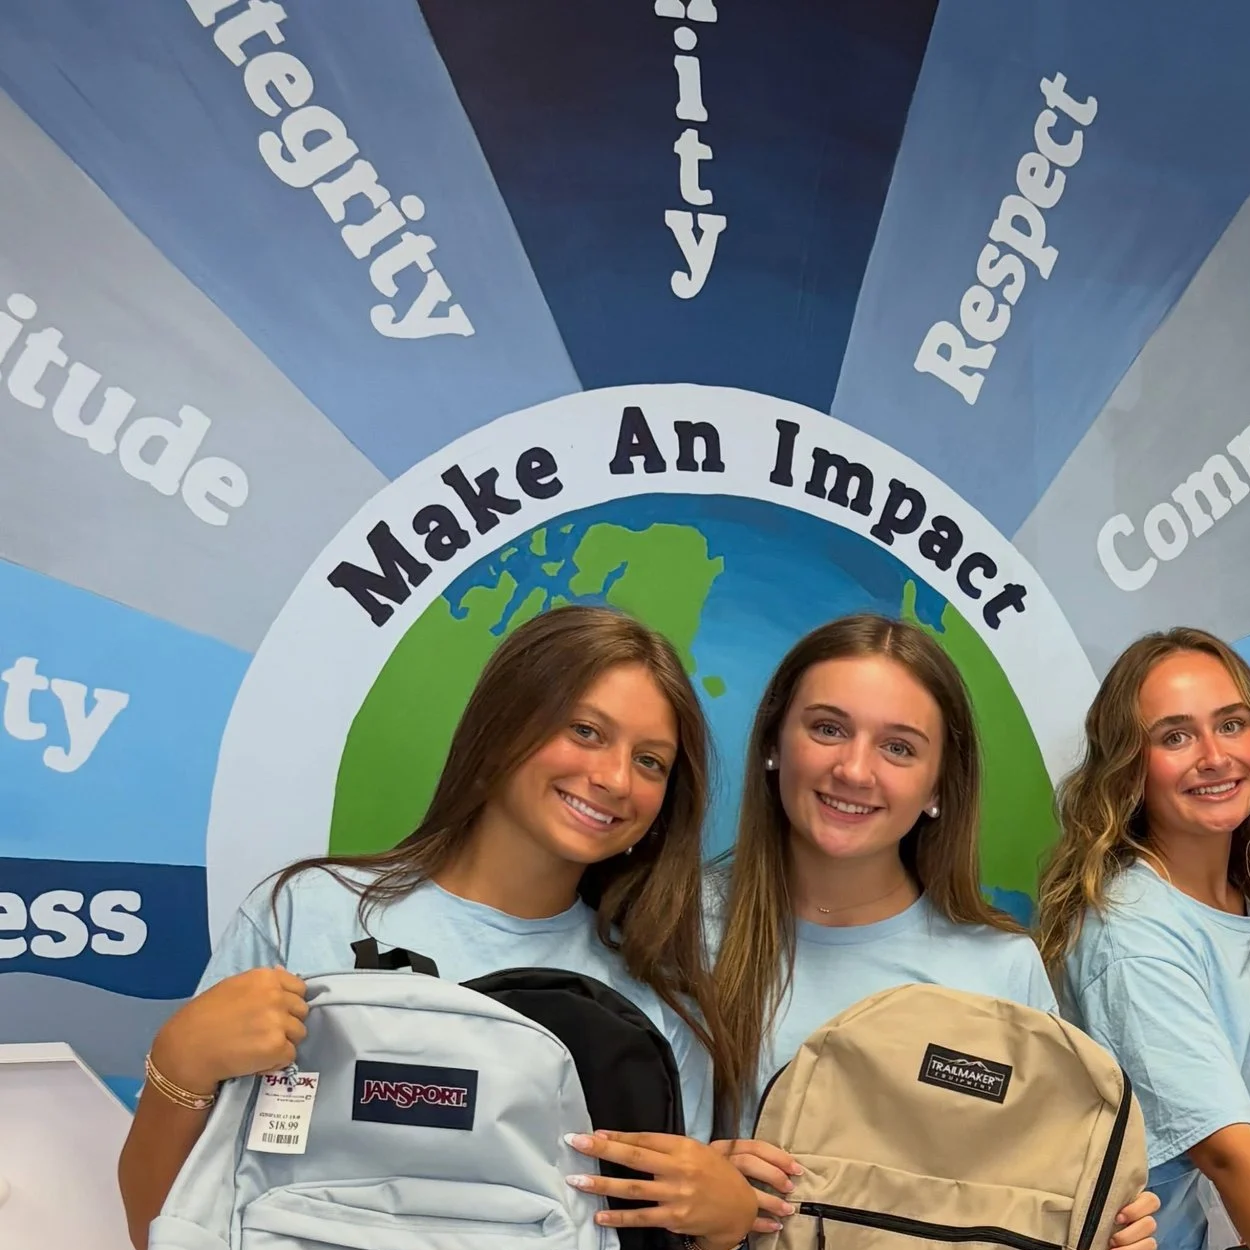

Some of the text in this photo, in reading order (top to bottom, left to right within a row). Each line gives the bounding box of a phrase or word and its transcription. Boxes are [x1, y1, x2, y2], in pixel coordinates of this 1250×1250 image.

[914, 72, 1098, 405] Respect
[328, 406, 1027, 630] Make An Impact
[268, 1120, 299, 1131] $18.99
[360, 1079, 467, 1109] JANSPORT
